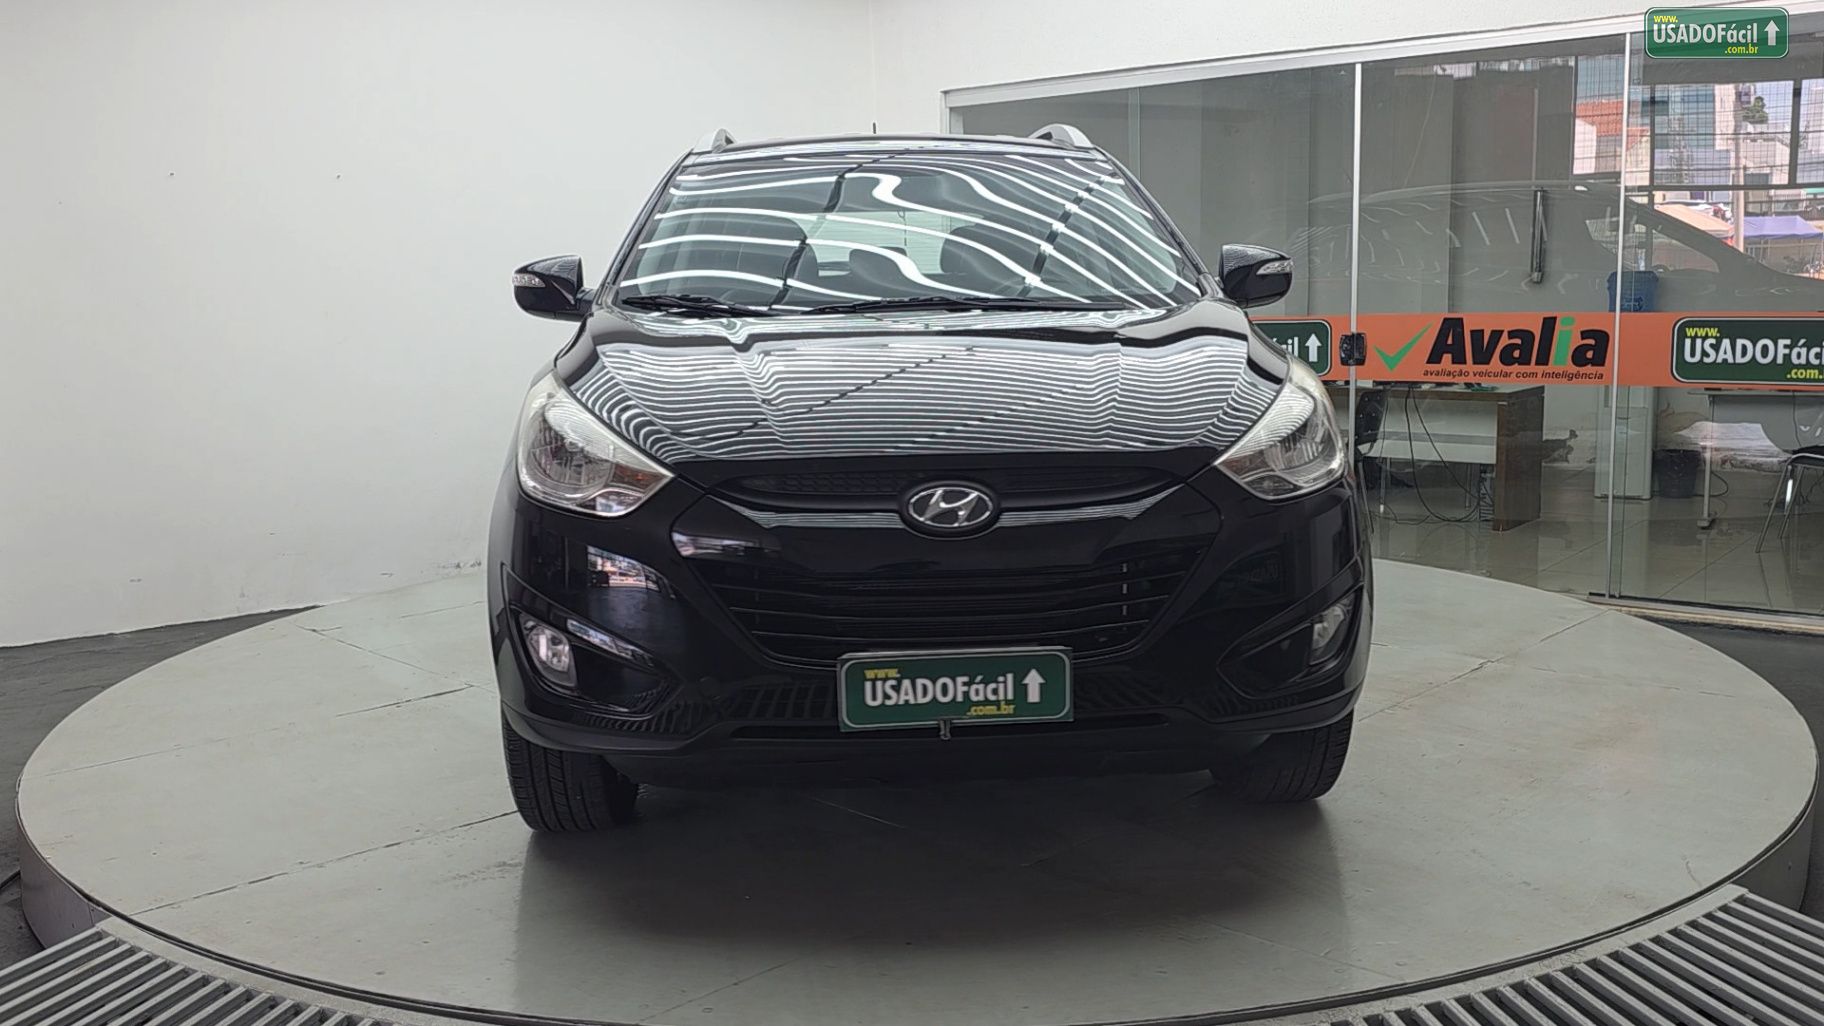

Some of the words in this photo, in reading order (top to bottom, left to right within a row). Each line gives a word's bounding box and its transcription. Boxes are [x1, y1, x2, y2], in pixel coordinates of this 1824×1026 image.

[1685, 327, 1720, 337] www.
[1426, 316, 1610, 368] Avalia
[1423, 369, 1470, 379] avaliação
[1472, 369, 1513, 379] veicular
[1515, 371, 1538, 379] com
[1541, 370, 1604, 381] inteligência
[864, 668, 900, 679] www.
[864, 673, 1014, 707] USADOFácil
[966, 702, 1015, 715] .com.br
